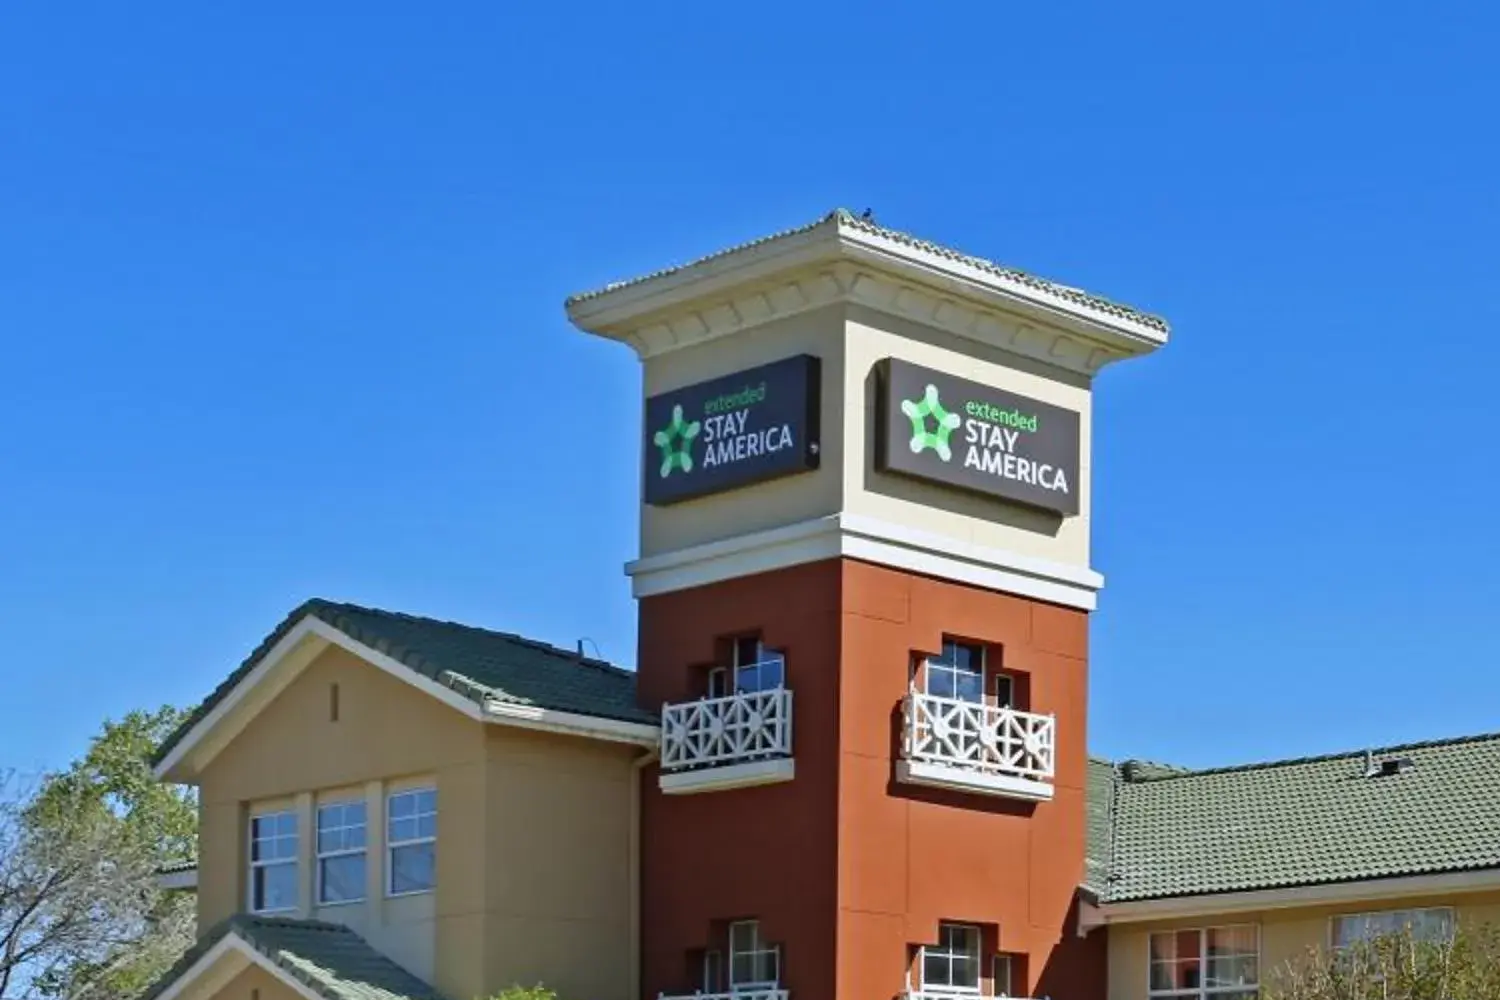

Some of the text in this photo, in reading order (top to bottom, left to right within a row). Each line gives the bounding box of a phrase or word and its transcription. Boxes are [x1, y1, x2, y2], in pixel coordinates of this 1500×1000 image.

[704, 408, 749, 442] STAY
[966, 401, 1037, 432] extended
[703, 424, 793, 468] AMERICA
[965, 419, 1019, 453] STAY
[964, 445, 1068, 494] AMERICA
